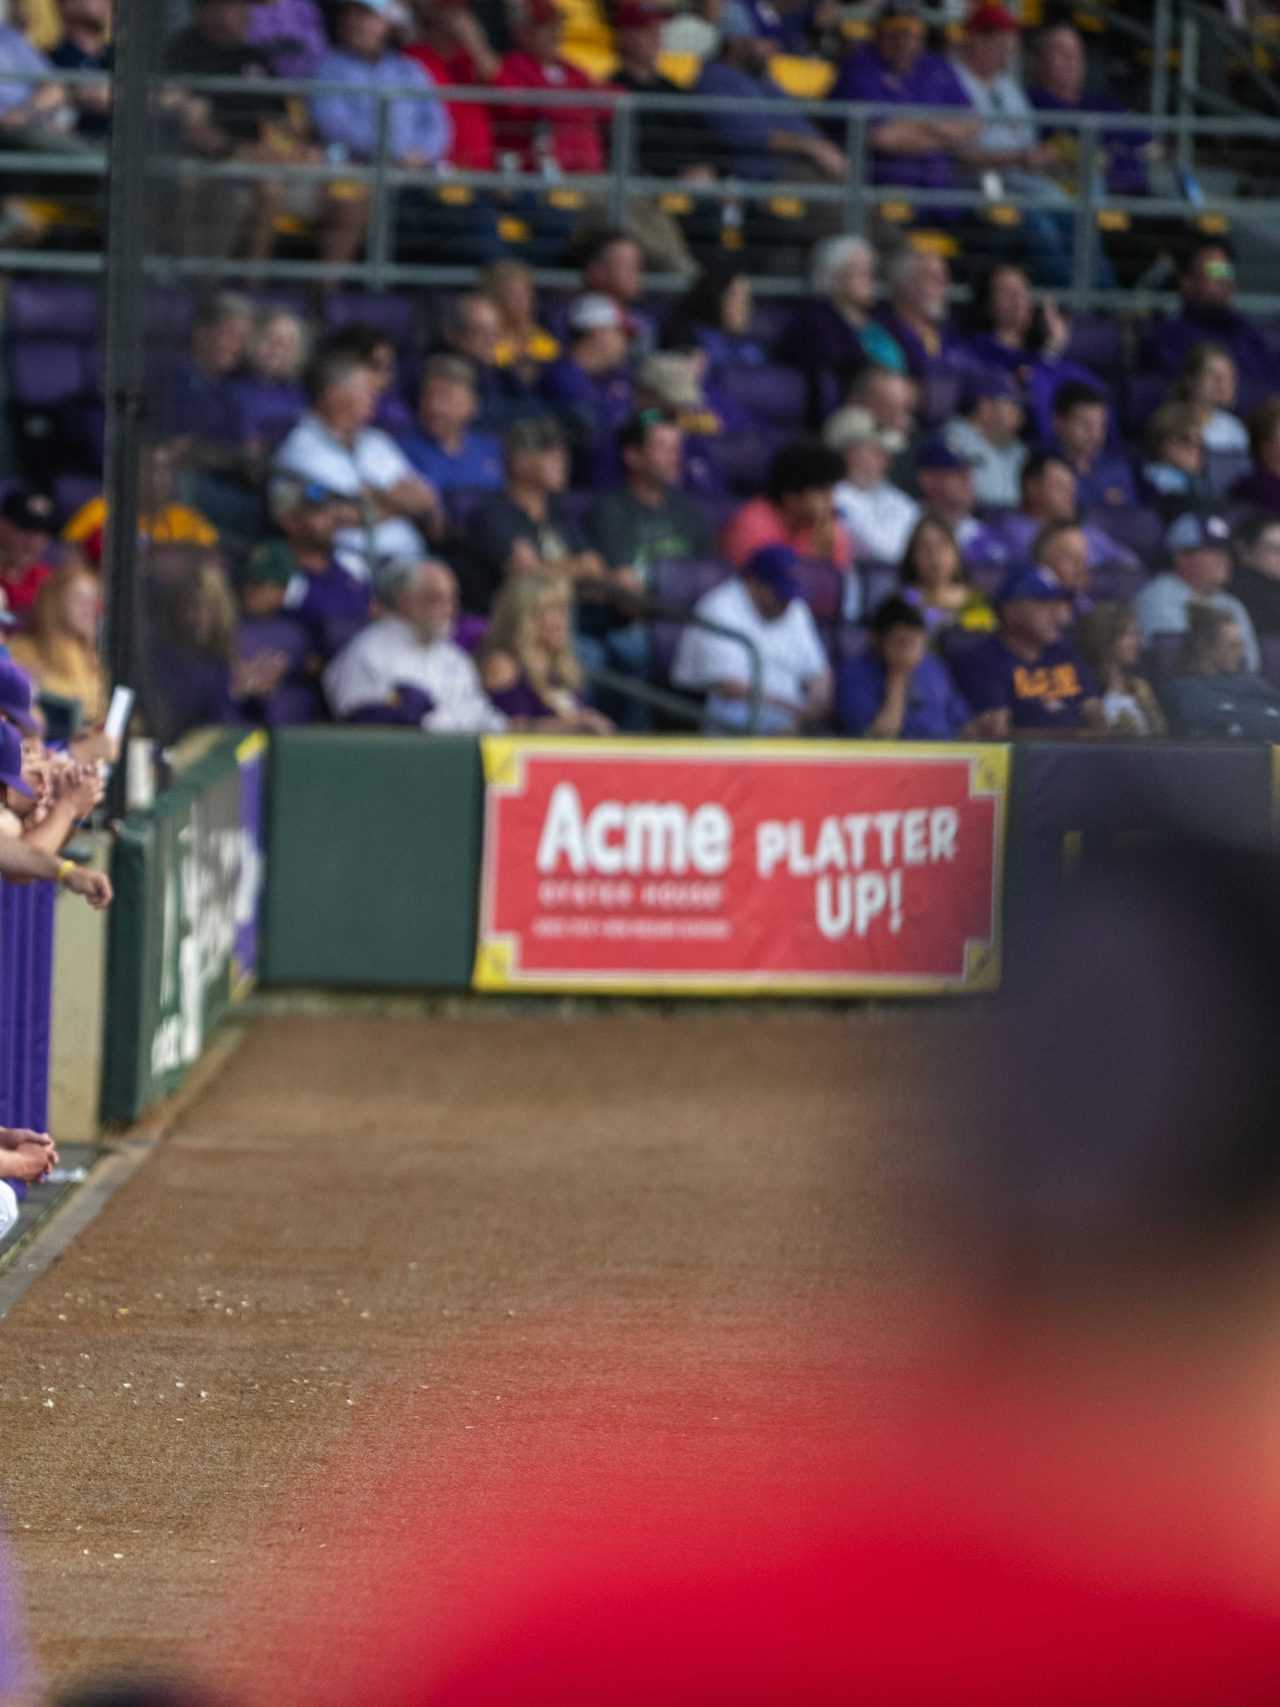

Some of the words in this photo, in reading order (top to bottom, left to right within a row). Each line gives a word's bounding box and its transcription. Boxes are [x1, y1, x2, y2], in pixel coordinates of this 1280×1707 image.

[538, 783, 732, 874] Acme
[755, 807, 959, 878] PLATTER
[816, 870, 903, 938] UP!
